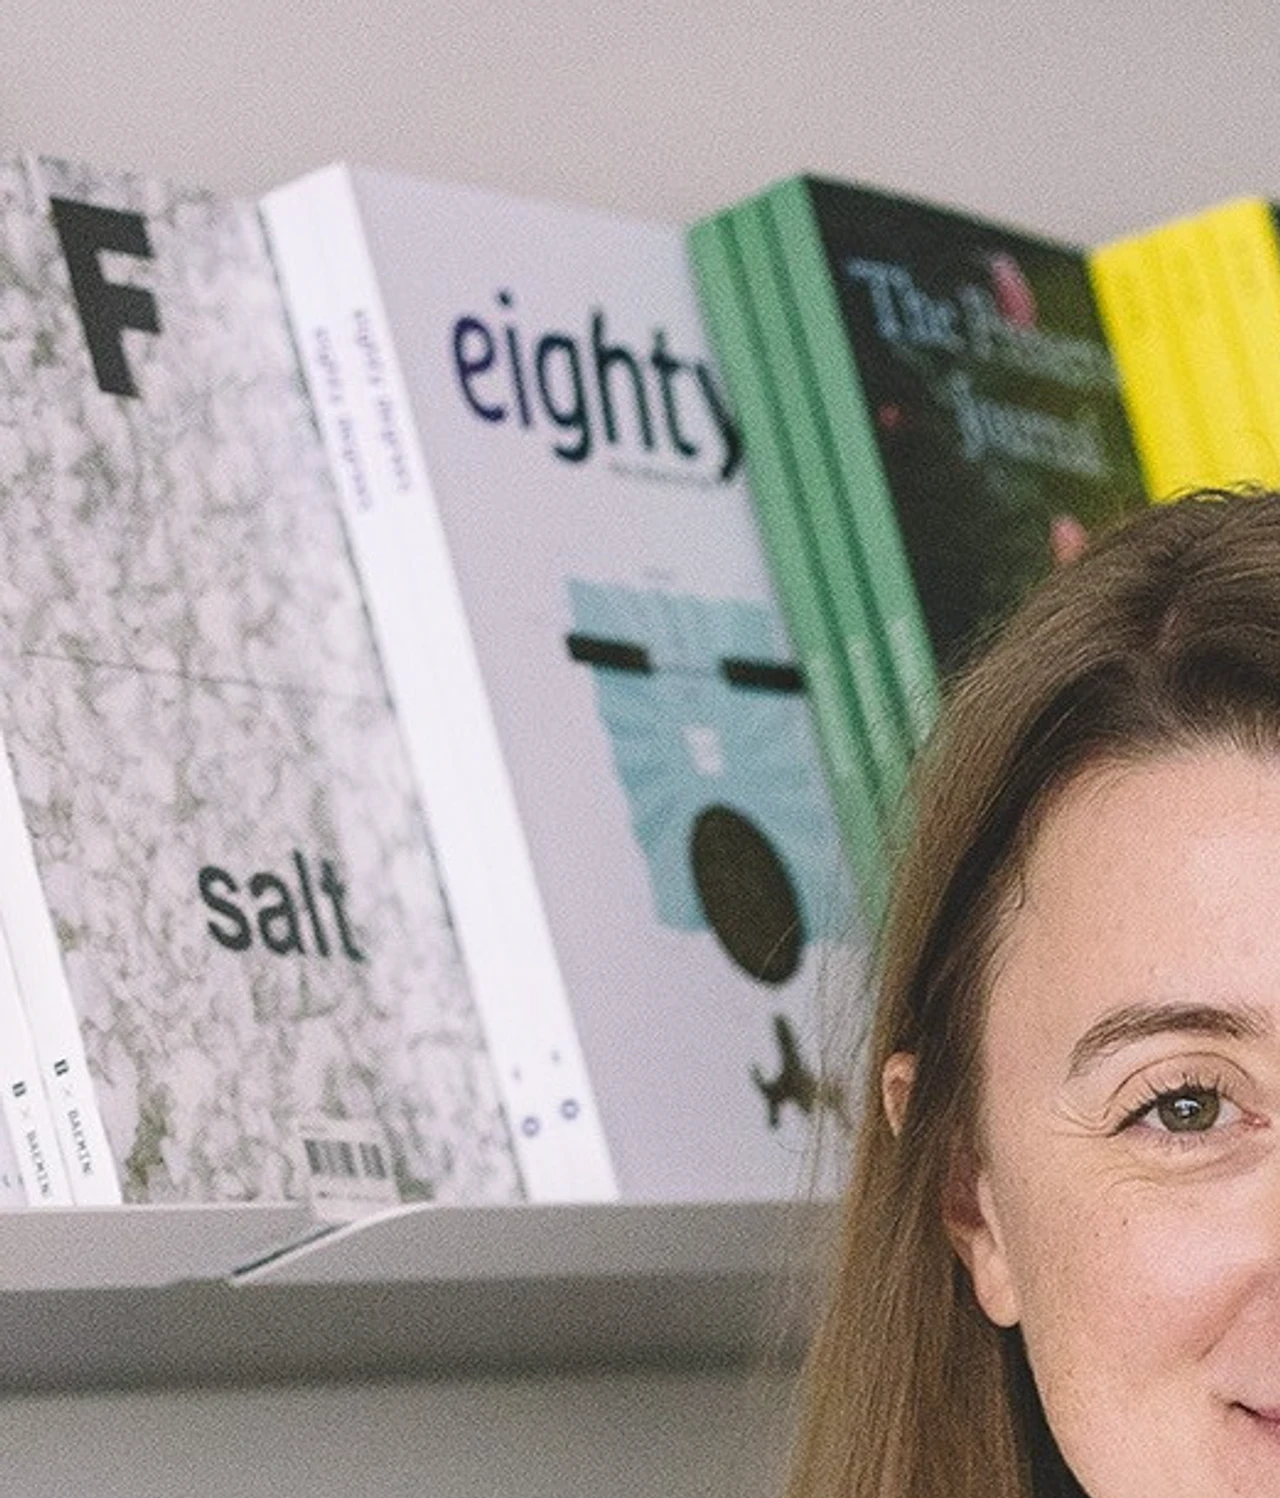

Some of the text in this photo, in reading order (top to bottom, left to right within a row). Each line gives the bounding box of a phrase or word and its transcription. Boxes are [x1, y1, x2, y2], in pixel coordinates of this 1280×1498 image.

[50, 196, 162, 400] F
[453, 287, 746, 482] eighty
[197, 849, 366, 964] salt
